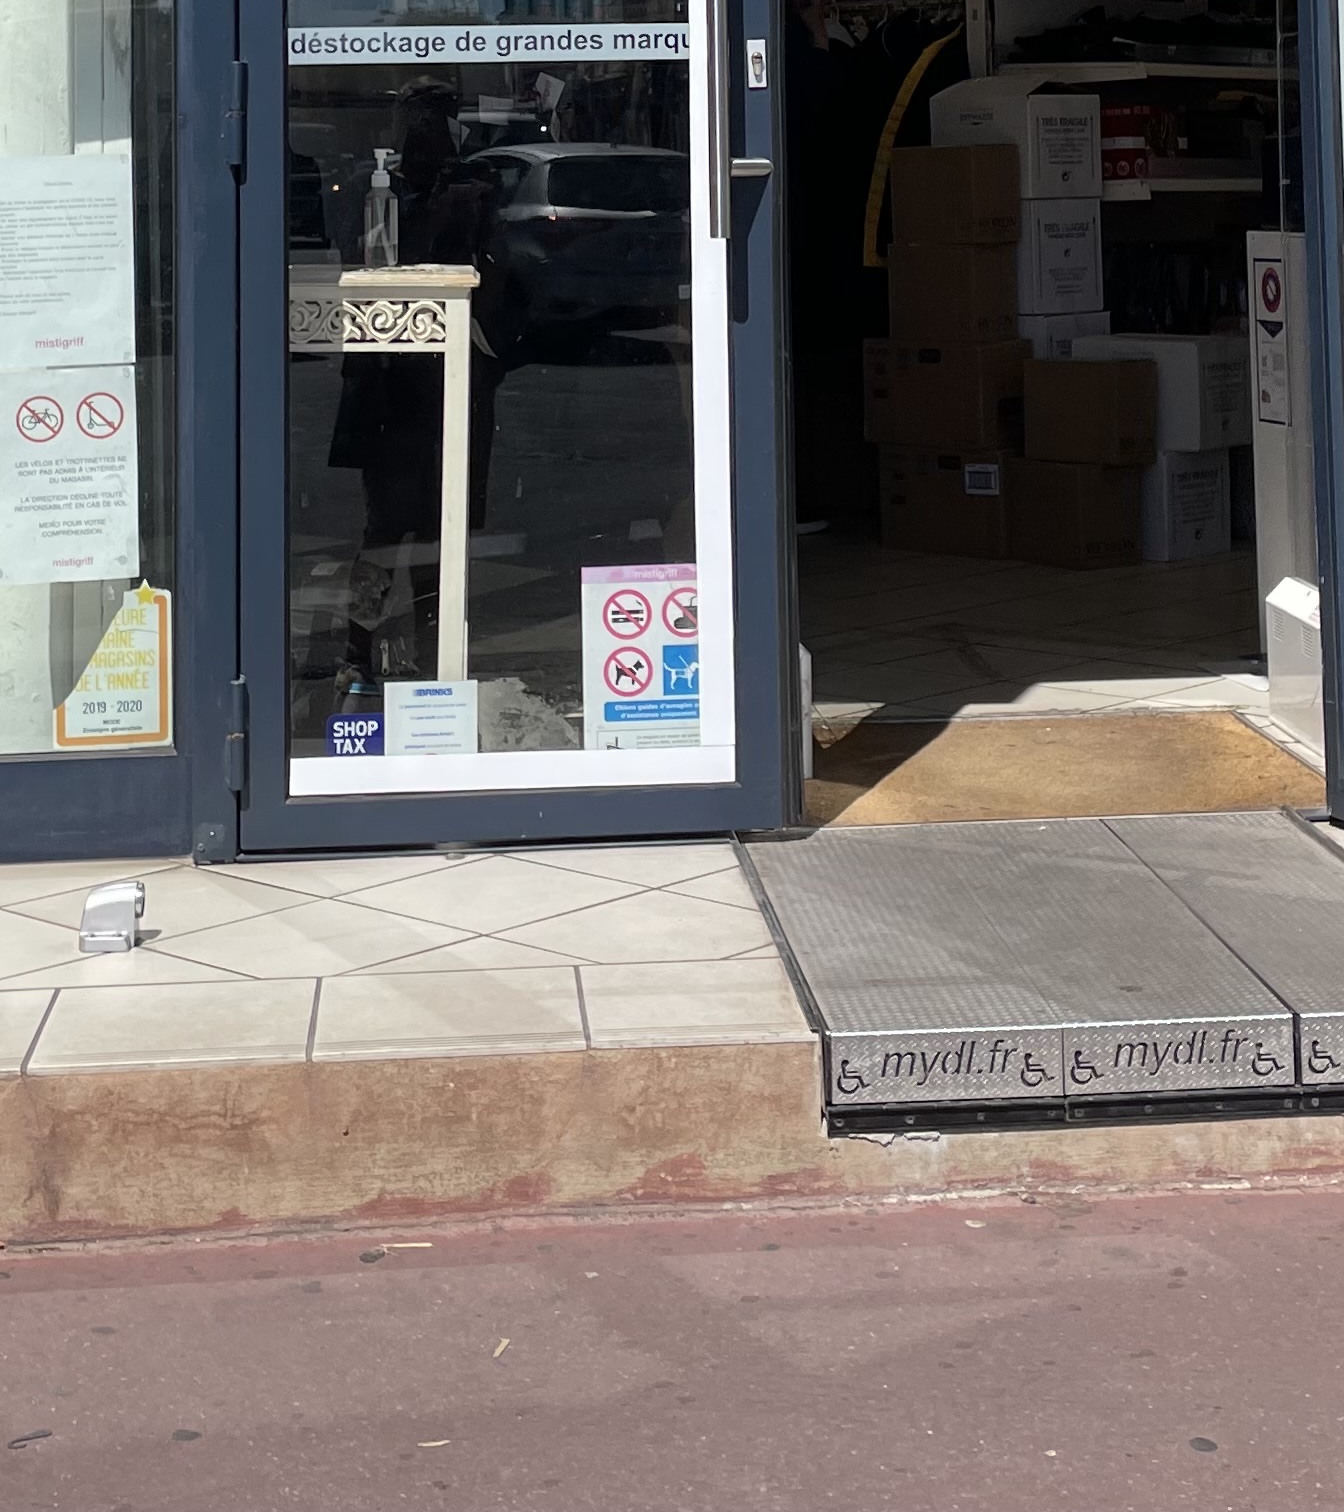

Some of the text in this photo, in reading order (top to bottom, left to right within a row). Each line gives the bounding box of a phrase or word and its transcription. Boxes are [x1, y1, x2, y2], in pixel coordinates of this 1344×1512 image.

[291, 29, 447, 59] déstockage
[455, 29, 488, 53] de
[496, 29, 604, 57] grandes
[35, 335, 85, 352] mistigriff
[51, 556, 94, 568] mistigriff
[82, 701, 107, 715] 2019
[116, 699, 143, 713] 2020
[332, 720, 379, 738] SHOP
[332, 738, 367, 754] TAX
[880, 1038, 1019, 1083] mydl.fr
[1112, 1027, 1252, 1072] mydl.fr
